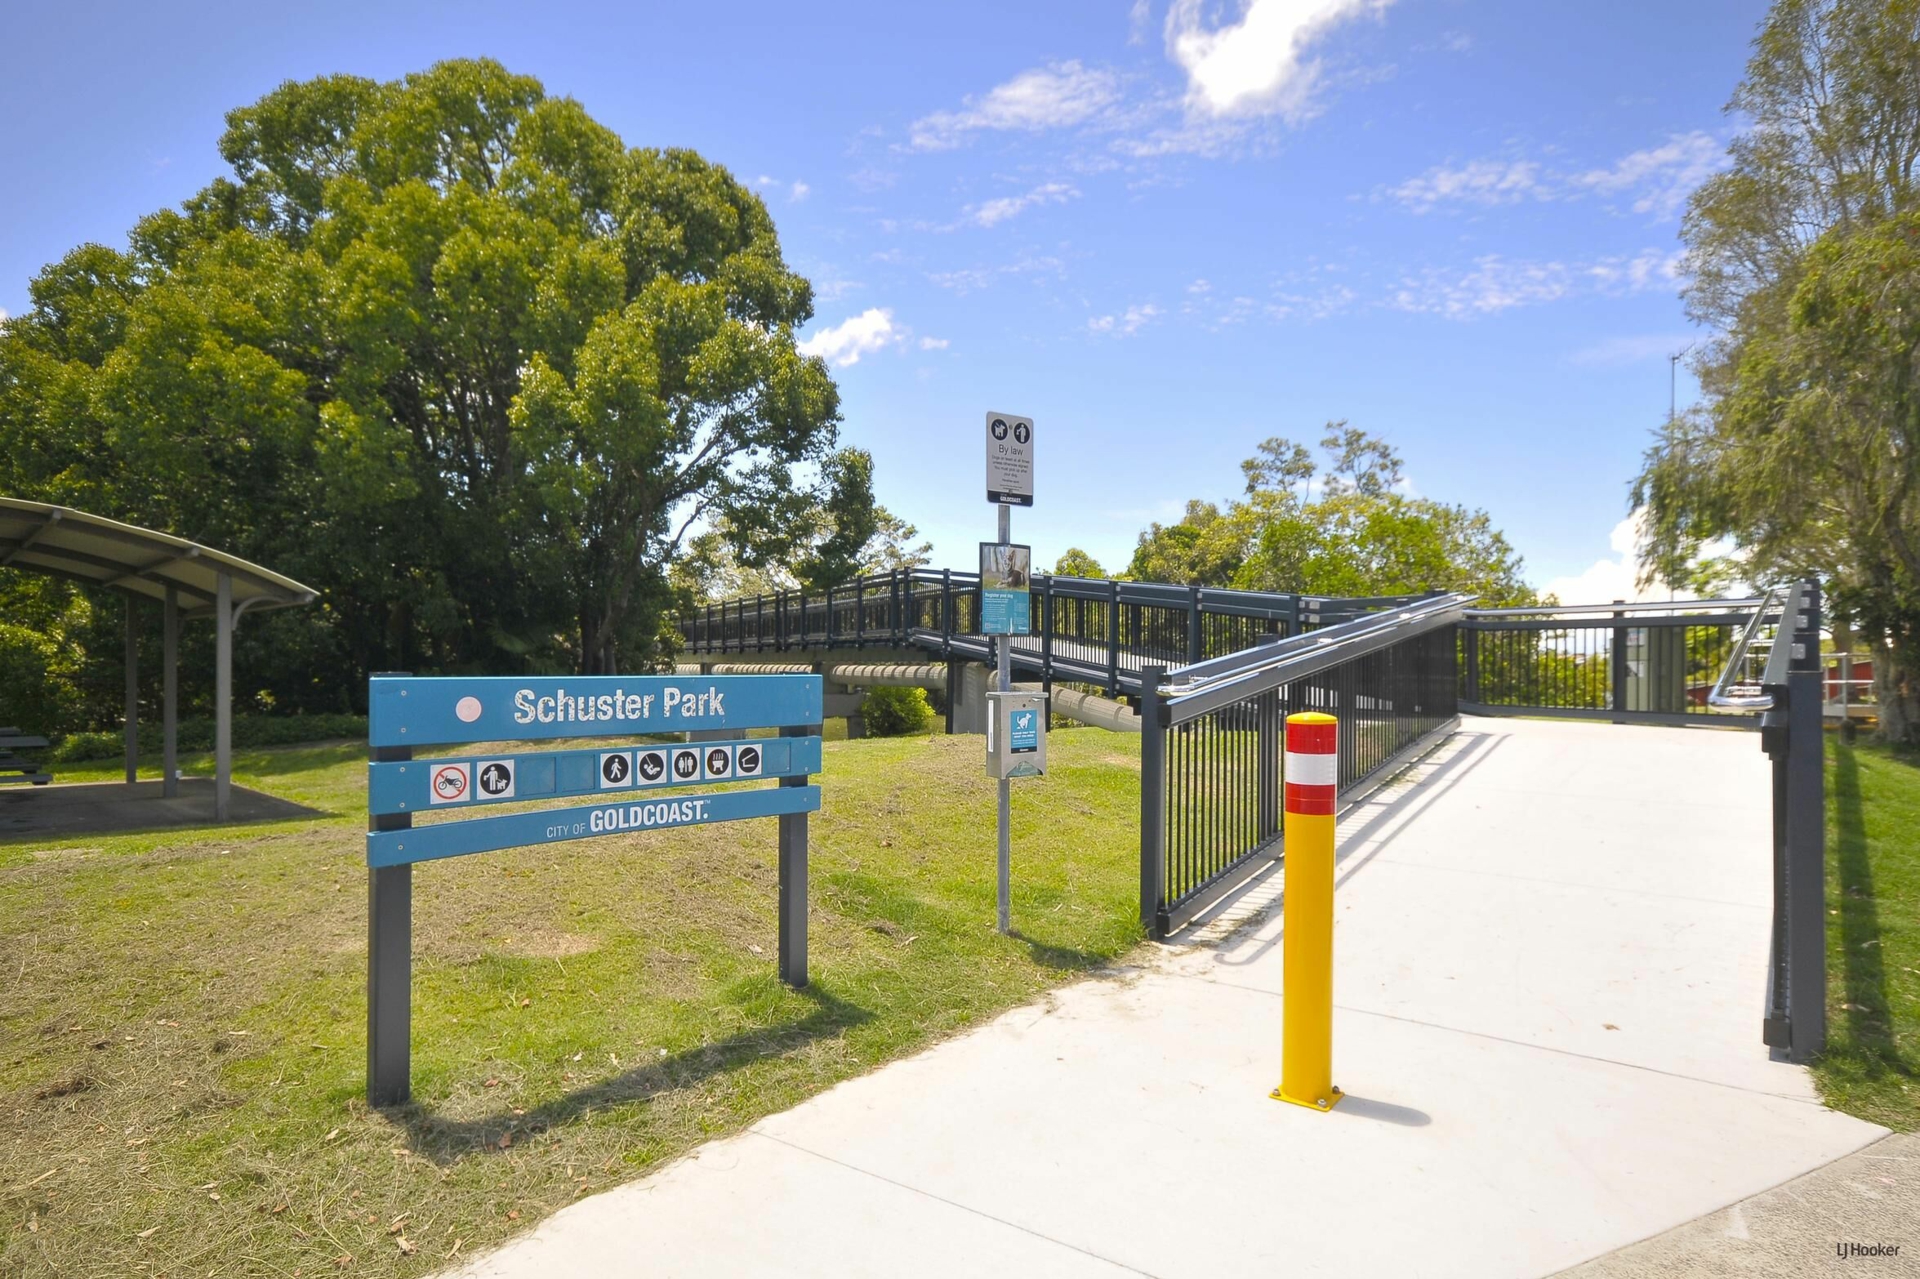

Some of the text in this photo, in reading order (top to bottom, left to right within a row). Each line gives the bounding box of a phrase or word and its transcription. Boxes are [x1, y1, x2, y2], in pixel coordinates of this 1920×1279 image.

[999, 444, 1023, 456] By law
[514, 687, 725, 724] Schuster Park
[546, 825, 569, 838] CITY
[572, 822, 586, 835] OF
